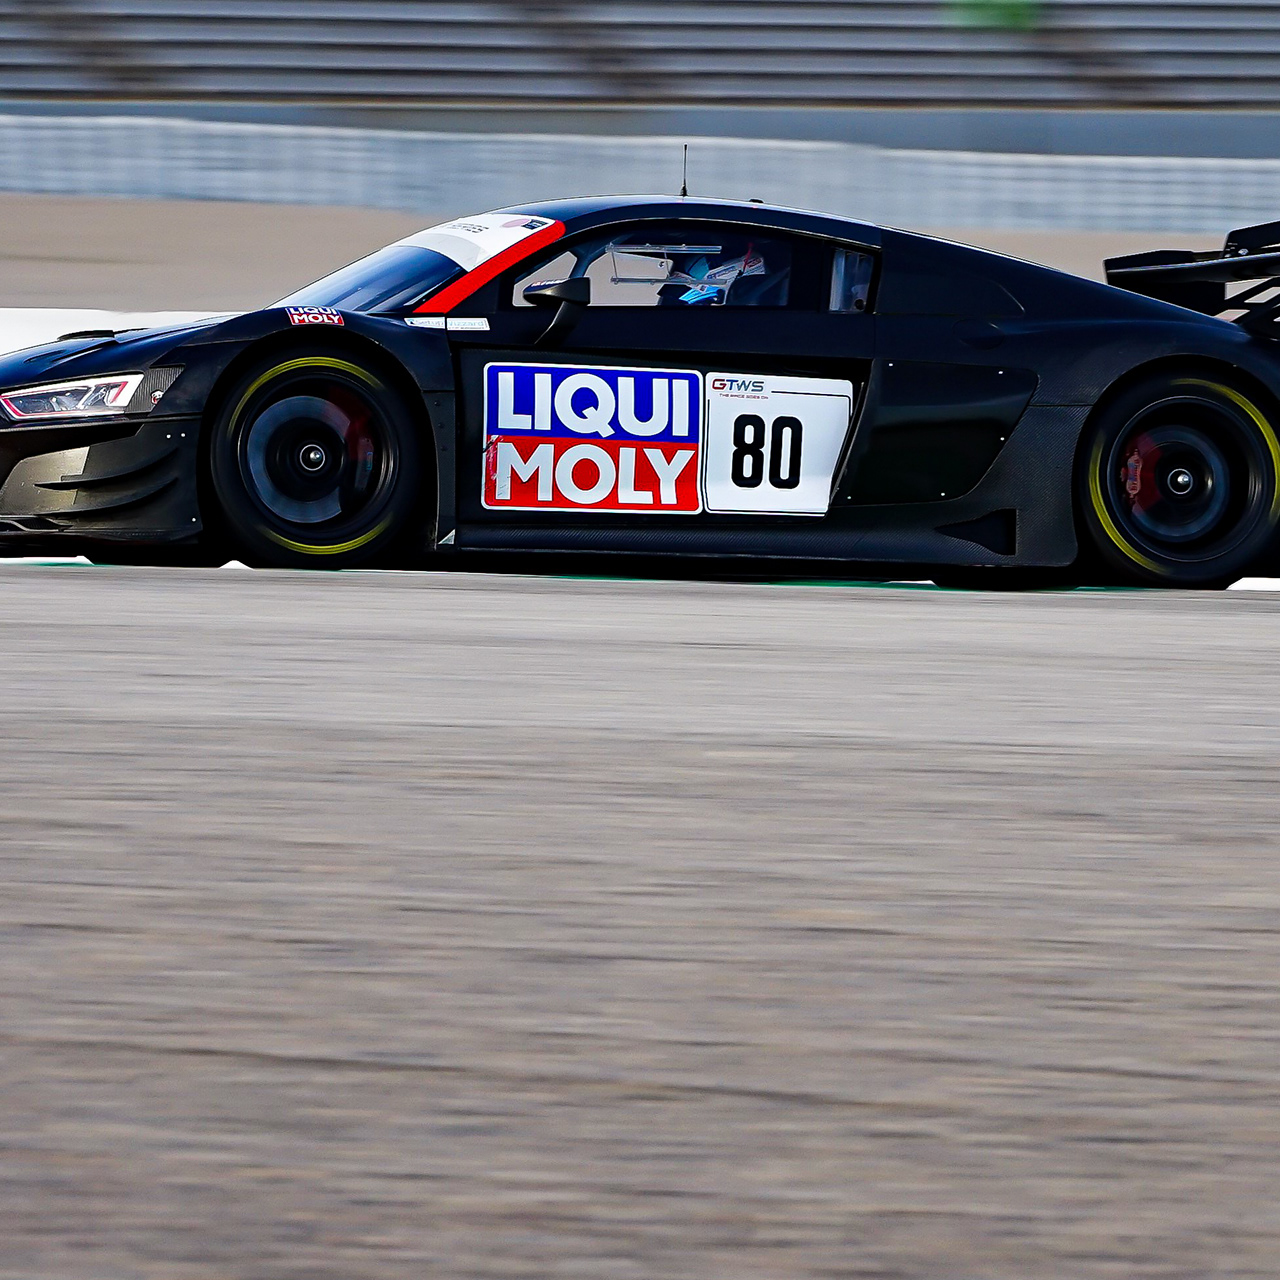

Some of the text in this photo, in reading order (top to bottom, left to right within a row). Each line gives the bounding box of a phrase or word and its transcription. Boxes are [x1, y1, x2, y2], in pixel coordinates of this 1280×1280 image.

[289, 306, 338, 315] LIQUI
[292, 314, 340, 324] MOLY
[711, 378, 765, 392] GTWS
[497, 371, 690, 439] LIQUI
[730, 413, 803, 490] 80
[494, 442, 696, 505] MOLY
